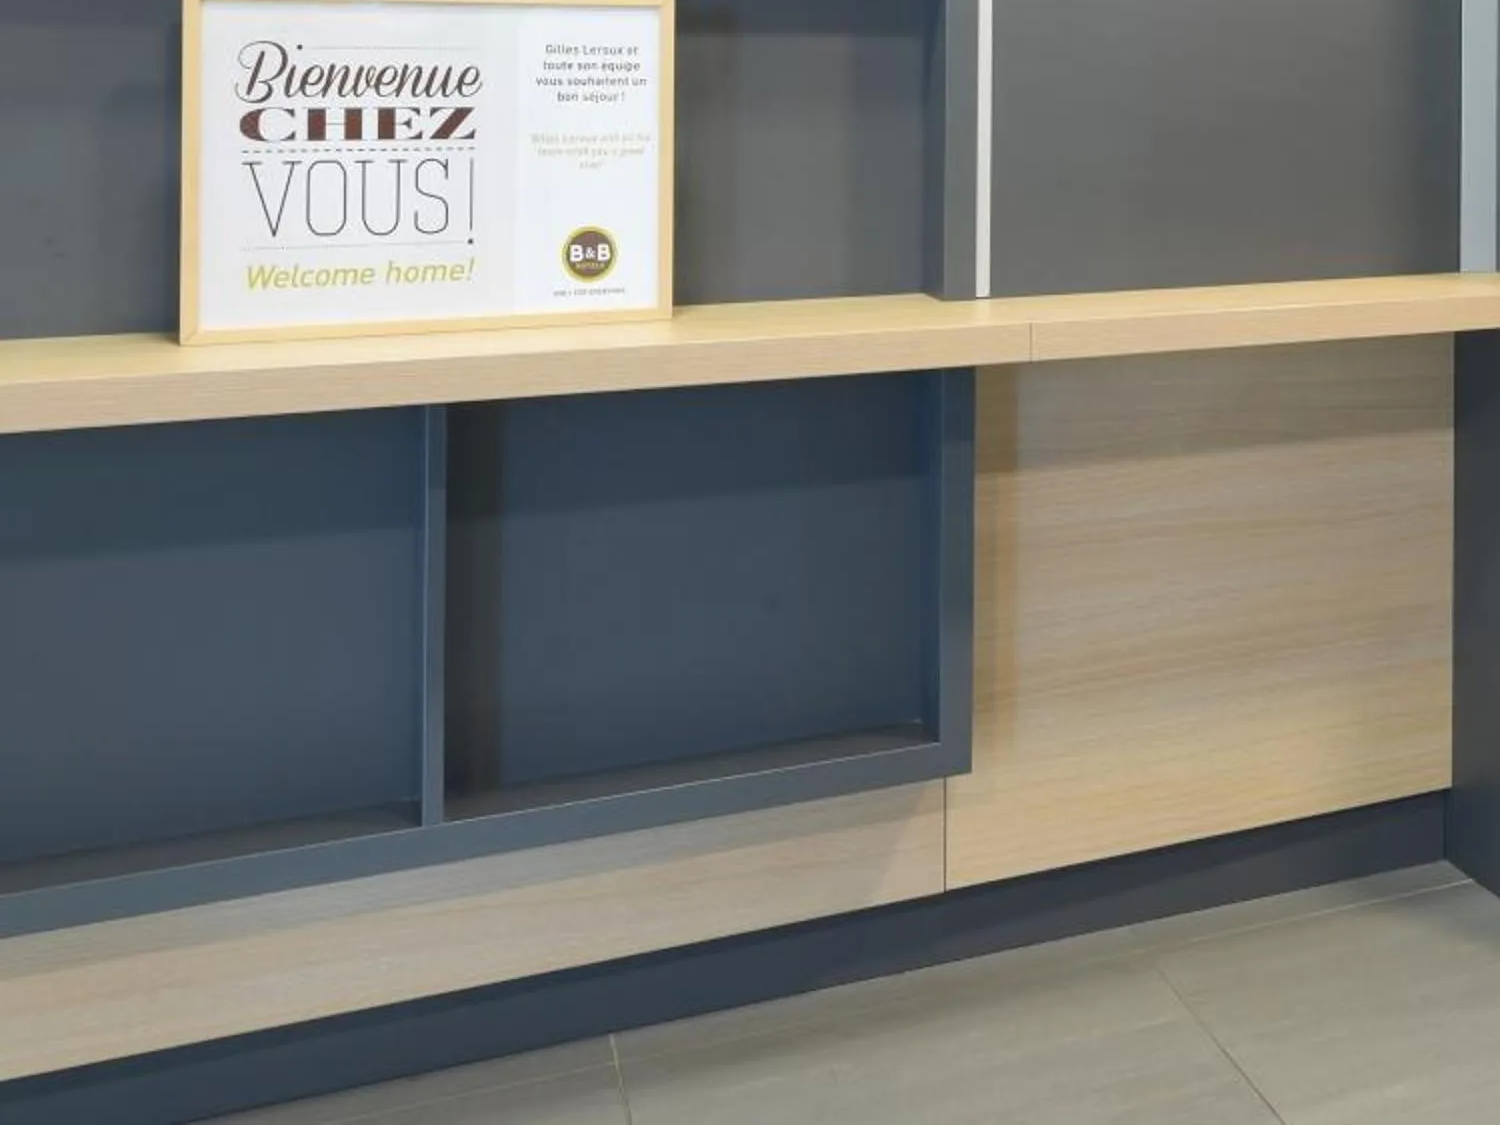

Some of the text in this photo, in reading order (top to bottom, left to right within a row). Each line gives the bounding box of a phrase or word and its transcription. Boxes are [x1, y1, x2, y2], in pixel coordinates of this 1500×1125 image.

[234, 40, 483, 104] Bienvenue
[535, 76, 648, 87] vous souhaitent un
[543, 61, 573, 71] toute
[557, 91, 579, 102] bon
[239, 106, 477, 143] CHEZ
[241, 157, 475, 246] VOUS!
[247, 256, 475, 290] Welcome home!
